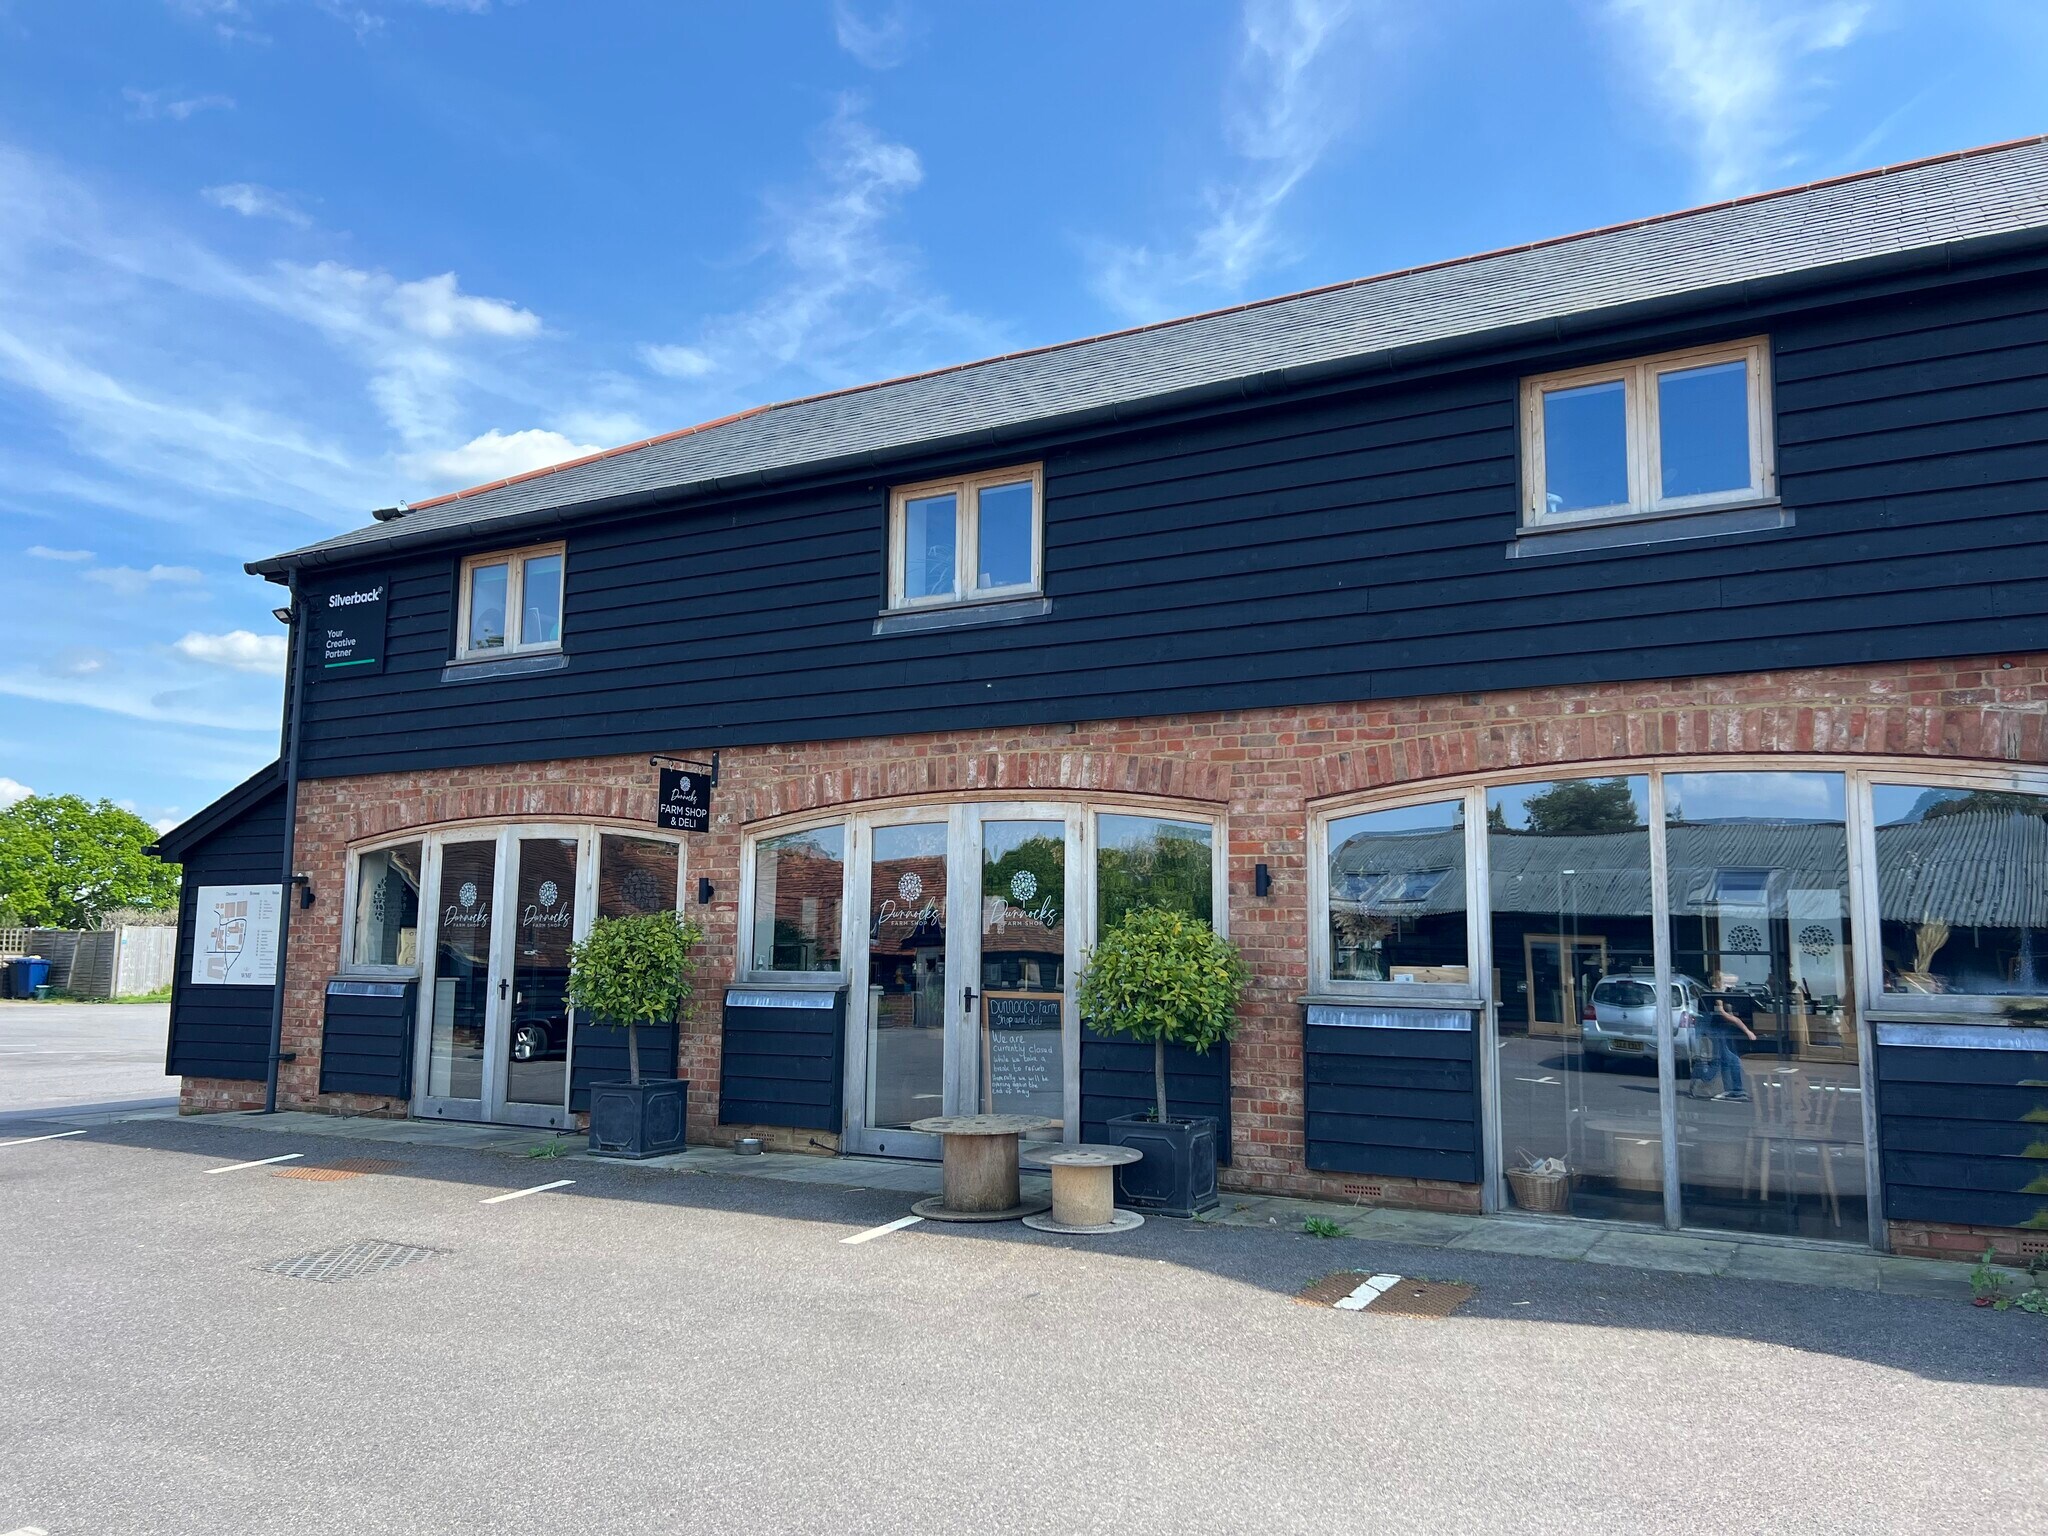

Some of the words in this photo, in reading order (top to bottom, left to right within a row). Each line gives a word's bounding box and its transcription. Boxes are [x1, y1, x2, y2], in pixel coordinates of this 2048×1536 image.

[329, 589, 379, 607] Silverback
[327, 630, 343, 638] Your
[326, 637, 356, 649] Creative
[325, 649, 352, 658] Partner
[661, 804, 683, 815] FARM
[685, 806, 707, 818] SHOP
[671, 817, 676, 825] &
[678, 817, 697, 828] DELI
[878, 895, 941, 927] Dunnocks
[991, 895, 1057, 926] Dunnocks
[992, 1030, 1008, 1044] We
[1009, 1035, 1025, 1043] are
[1013, 1064, 1022, 1072] to
